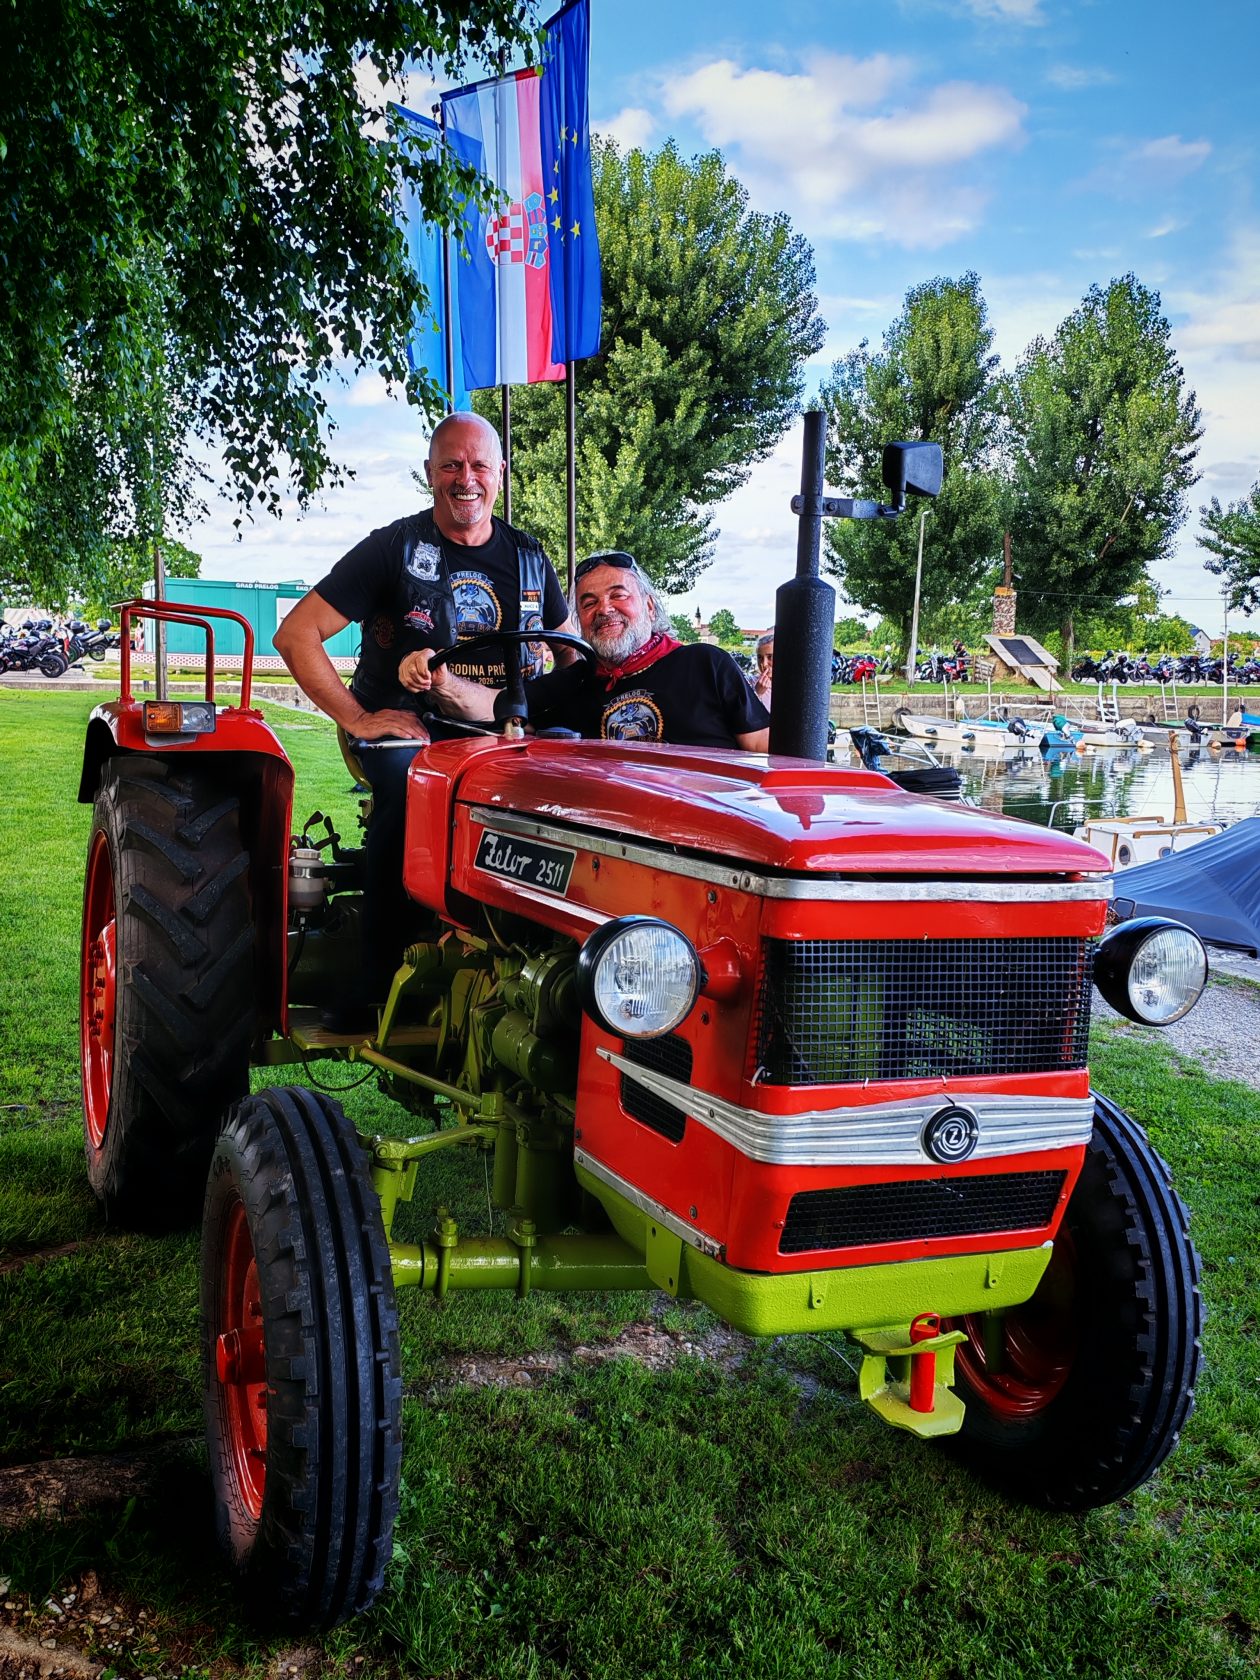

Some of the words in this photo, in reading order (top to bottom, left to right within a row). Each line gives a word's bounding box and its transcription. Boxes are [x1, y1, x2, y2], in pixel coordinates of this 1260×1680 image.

[456, 571, 482, 580] PRELOG
[449, 663, 485, 676] GODINA
[616, 690, 641, 702] PRELOG
[484, 833, 533, 875] Zetor
[535, 859, 565, 887] 2511
[949, 1128, 959, 1144] Z
